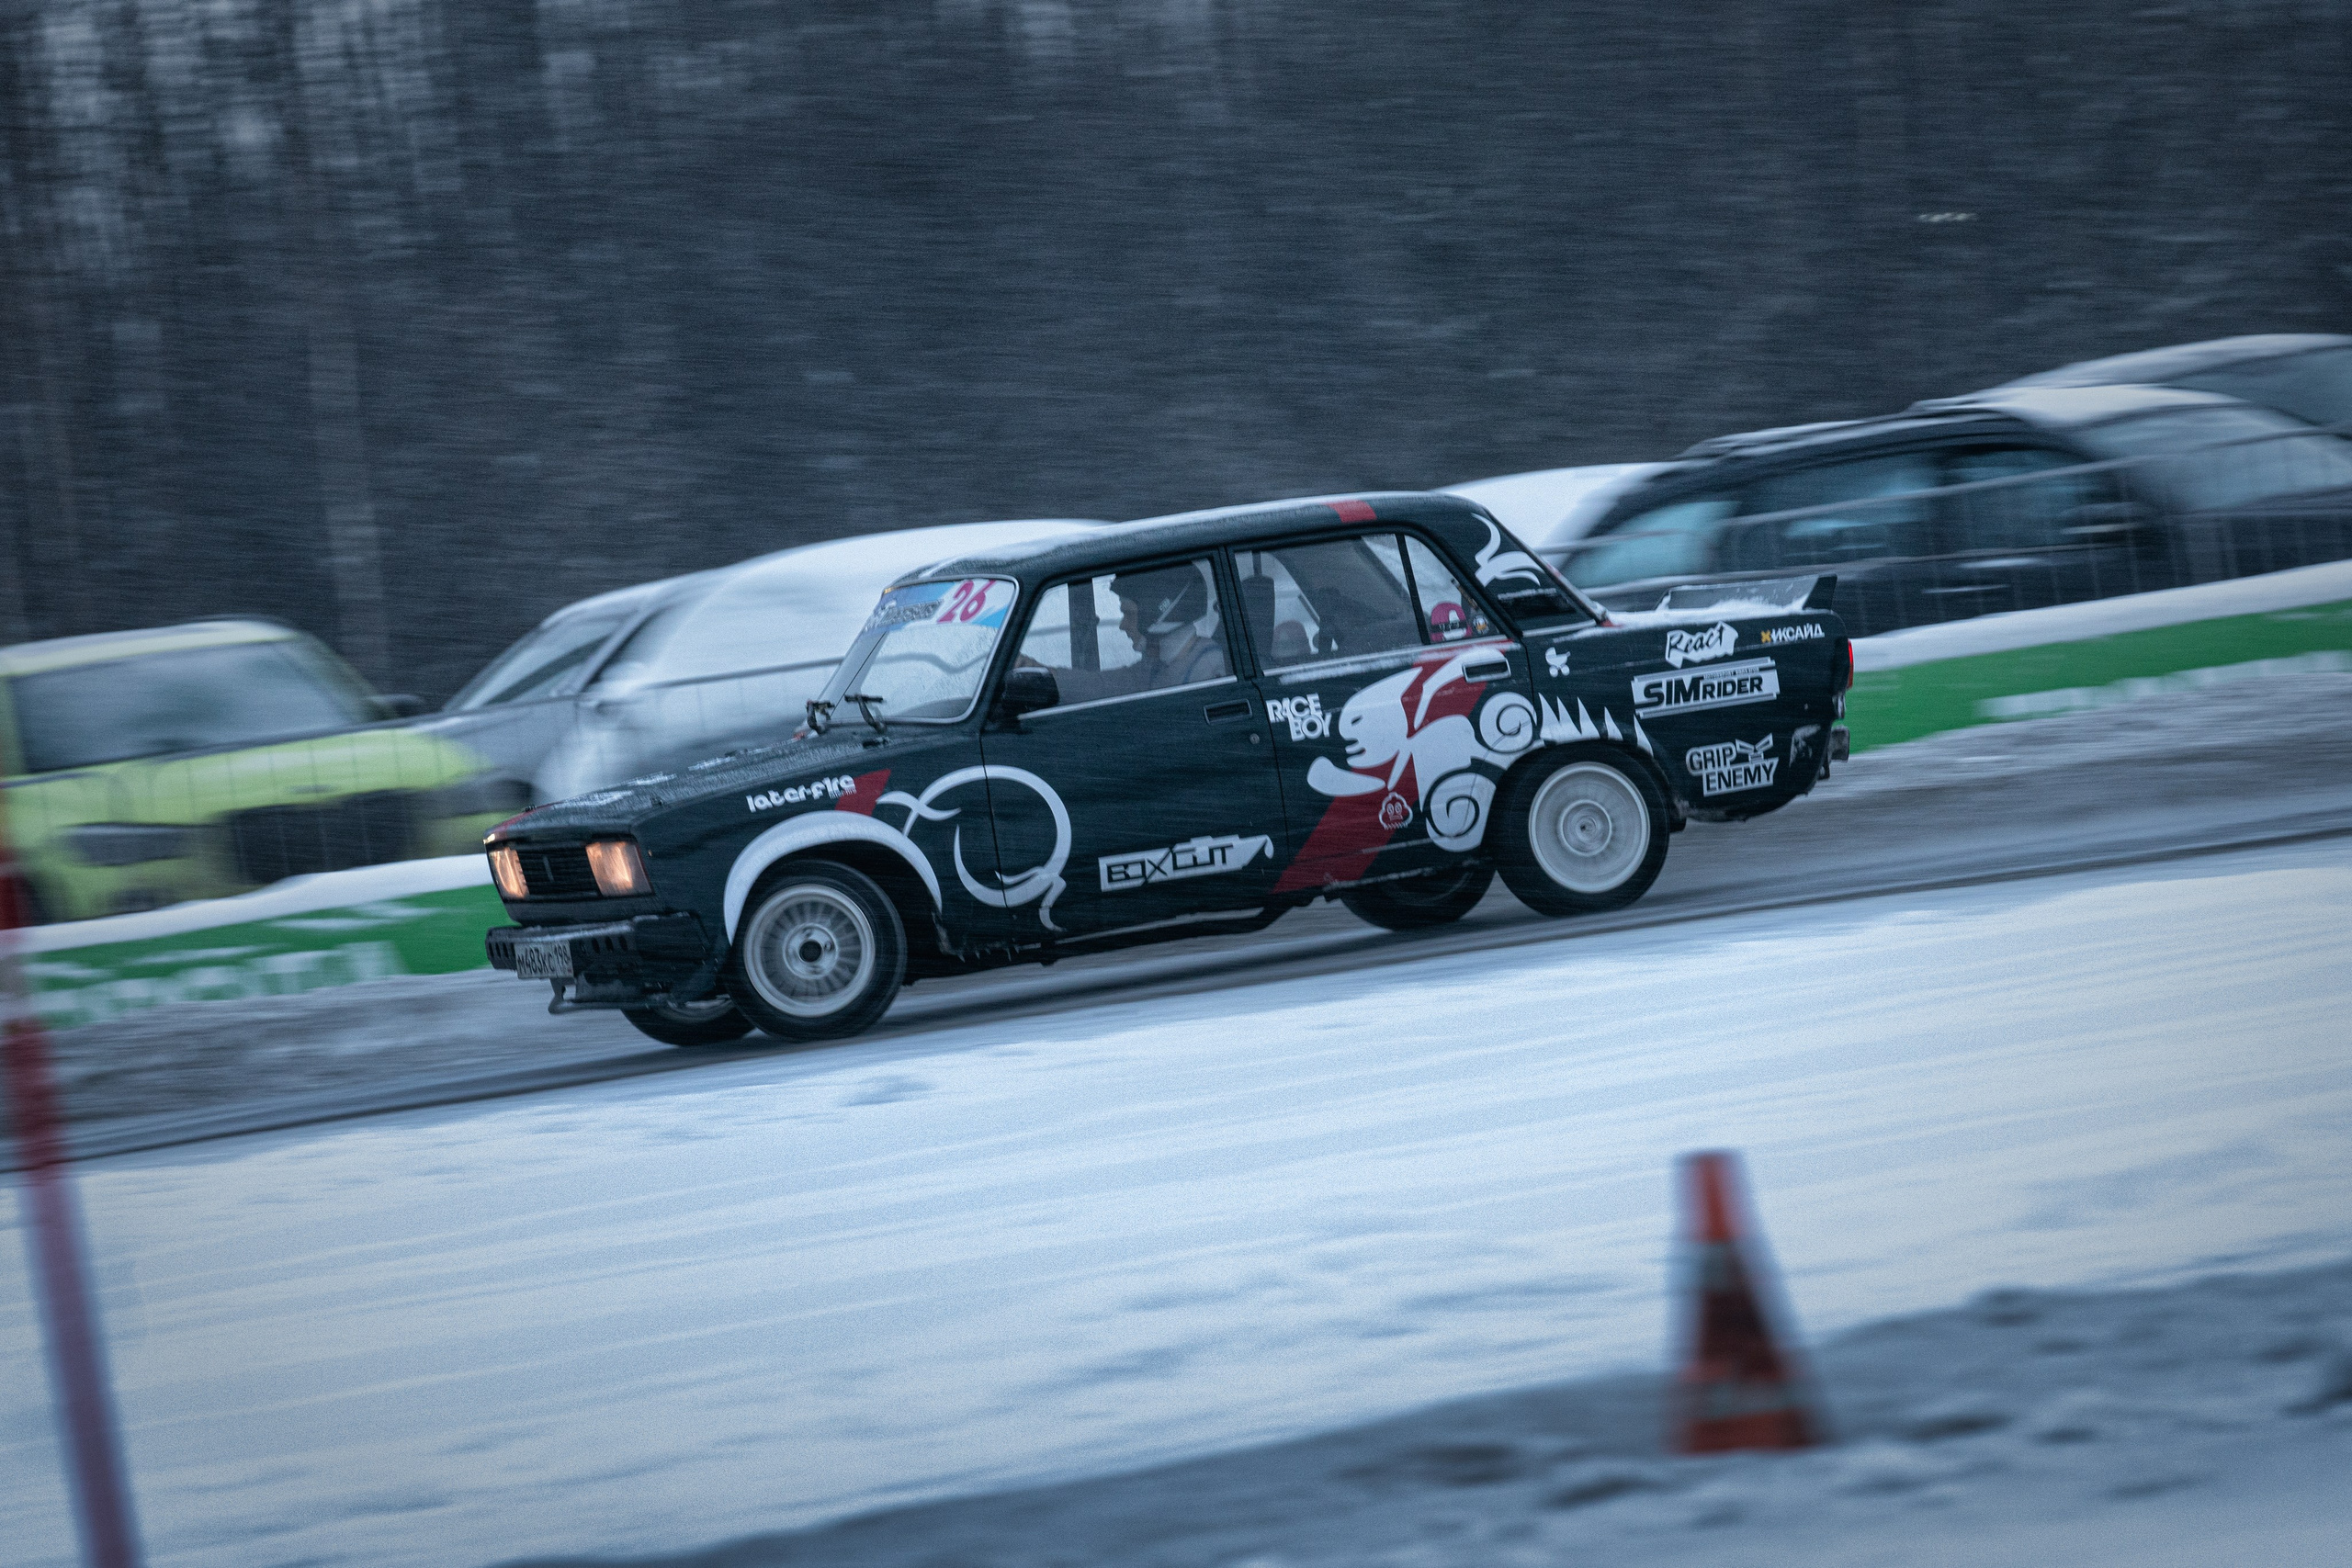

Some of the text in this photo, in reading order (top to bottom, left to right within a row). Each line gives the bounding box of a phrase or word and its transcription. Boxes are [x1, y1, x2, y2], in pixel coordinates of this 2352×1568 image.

[937, 580, 997, 624] 26
[1635, 673, 1763, 708] SIMRIDER
[1265, 693, 1323, 724] RACE
[1287, 712, 1332, 742] BOY
[1689, 745, 1735, 773] GRIP
[1706, 761, 1777, 793] ENEMY
